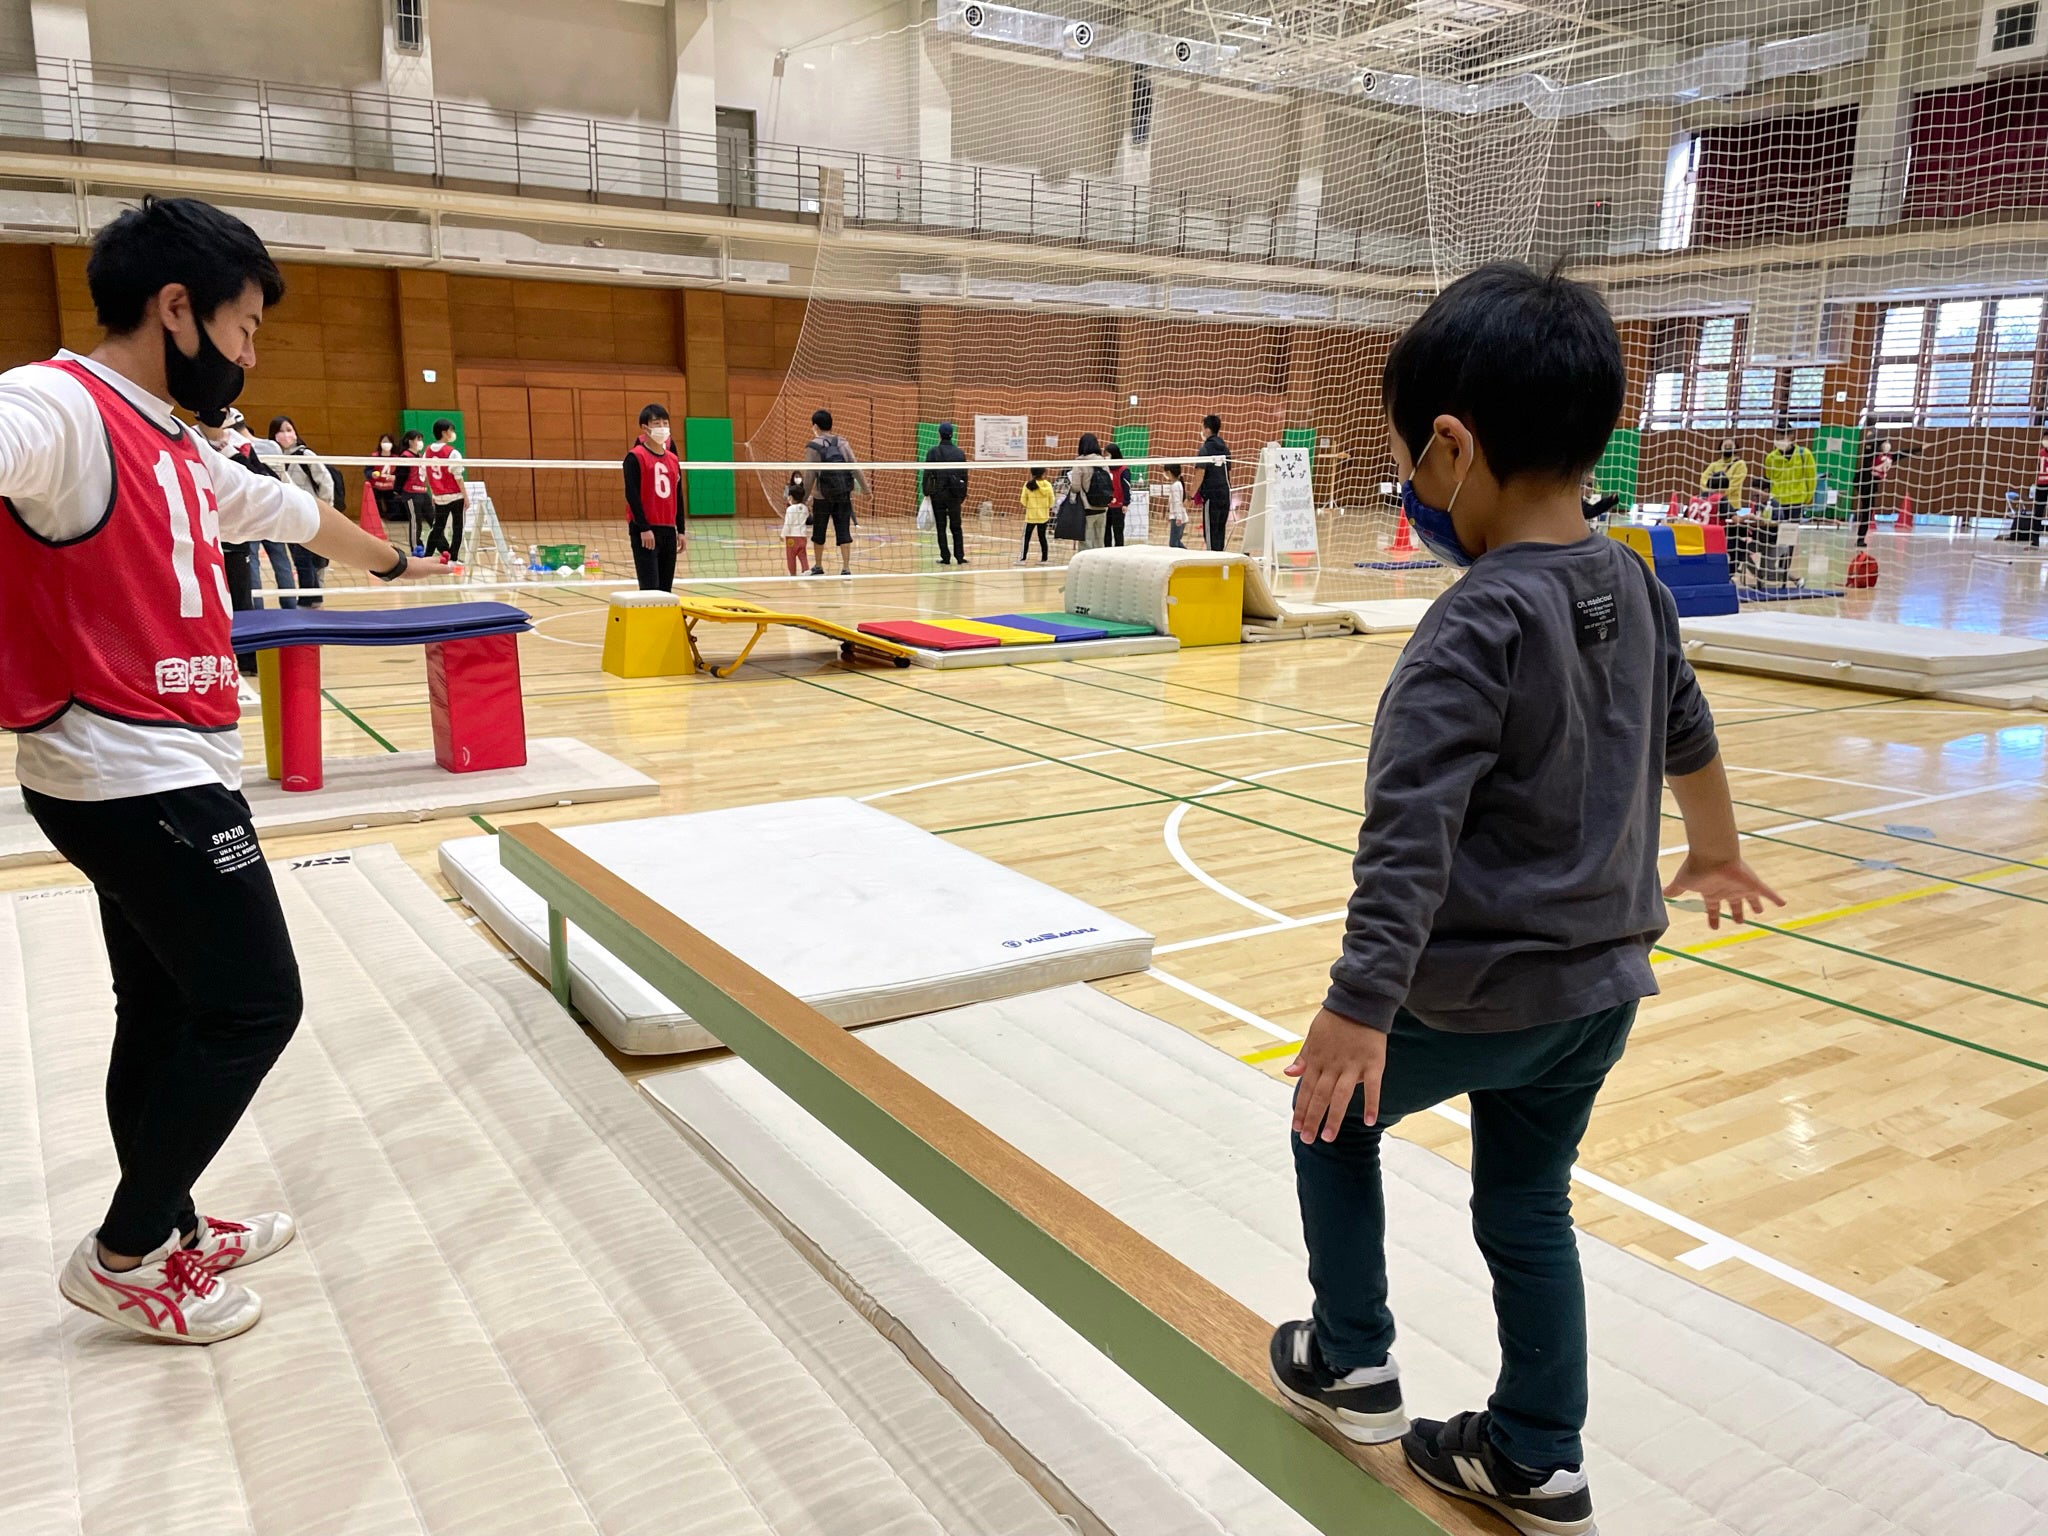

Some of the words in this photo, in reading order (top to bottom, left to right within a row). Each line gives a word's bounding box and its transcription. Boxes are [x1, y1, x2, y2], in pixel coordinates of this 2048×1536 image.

[654, 461, 671, 499] 6
[1687, 501, 1712, 525] 23
[153, 450, 234, 618] 15
[211, 825, 245, 845] SPAZIO
[219, 847, 233, 856] UNA
[1024, 927, 1100, 944] KUSAKURA
[1292, 1329, 1311, 1366] N
[1451, 1455, 1499, 1497] N
